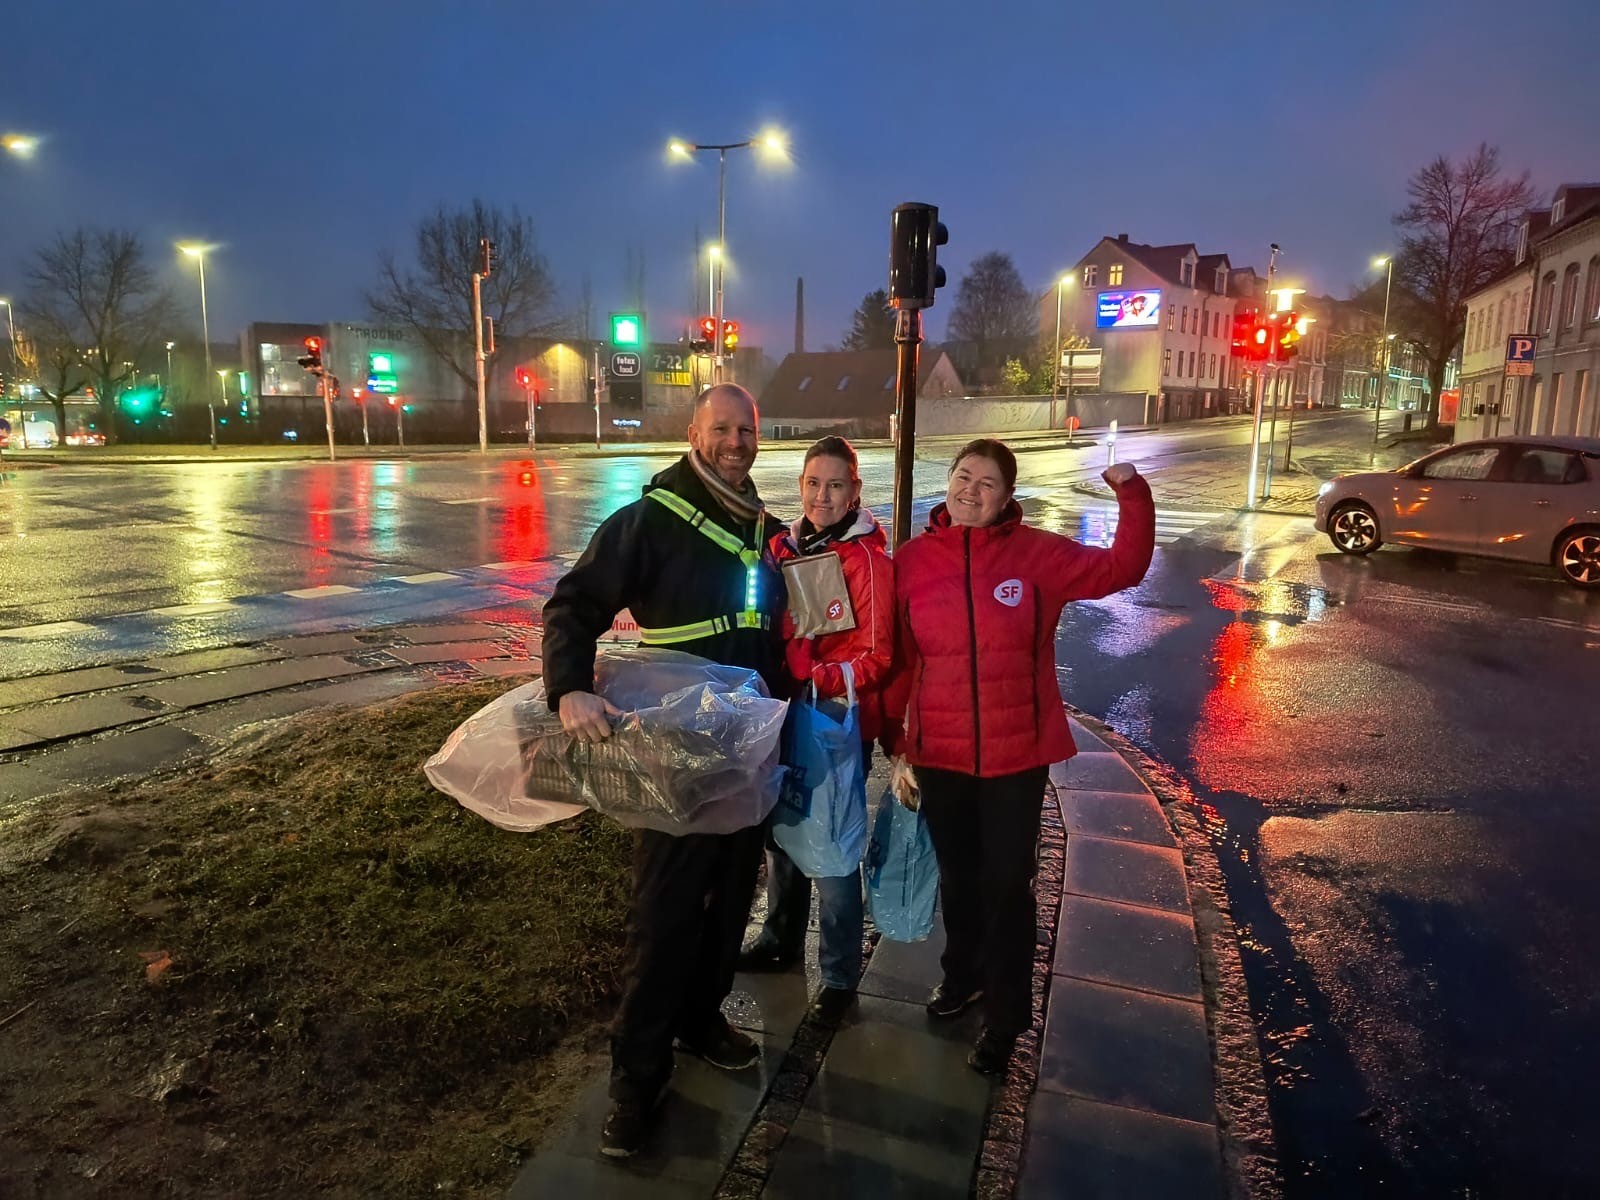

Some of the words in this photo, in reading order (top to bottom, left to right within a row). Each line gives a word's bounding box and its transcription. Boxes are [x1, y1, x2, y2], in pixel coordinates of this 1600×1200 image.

[1513, 339, 1532, 359] P
[653, 354, 683, 370] 7-22
[1001, 585, 1019, 599] SF
[829, 603, 841, 618] SF
